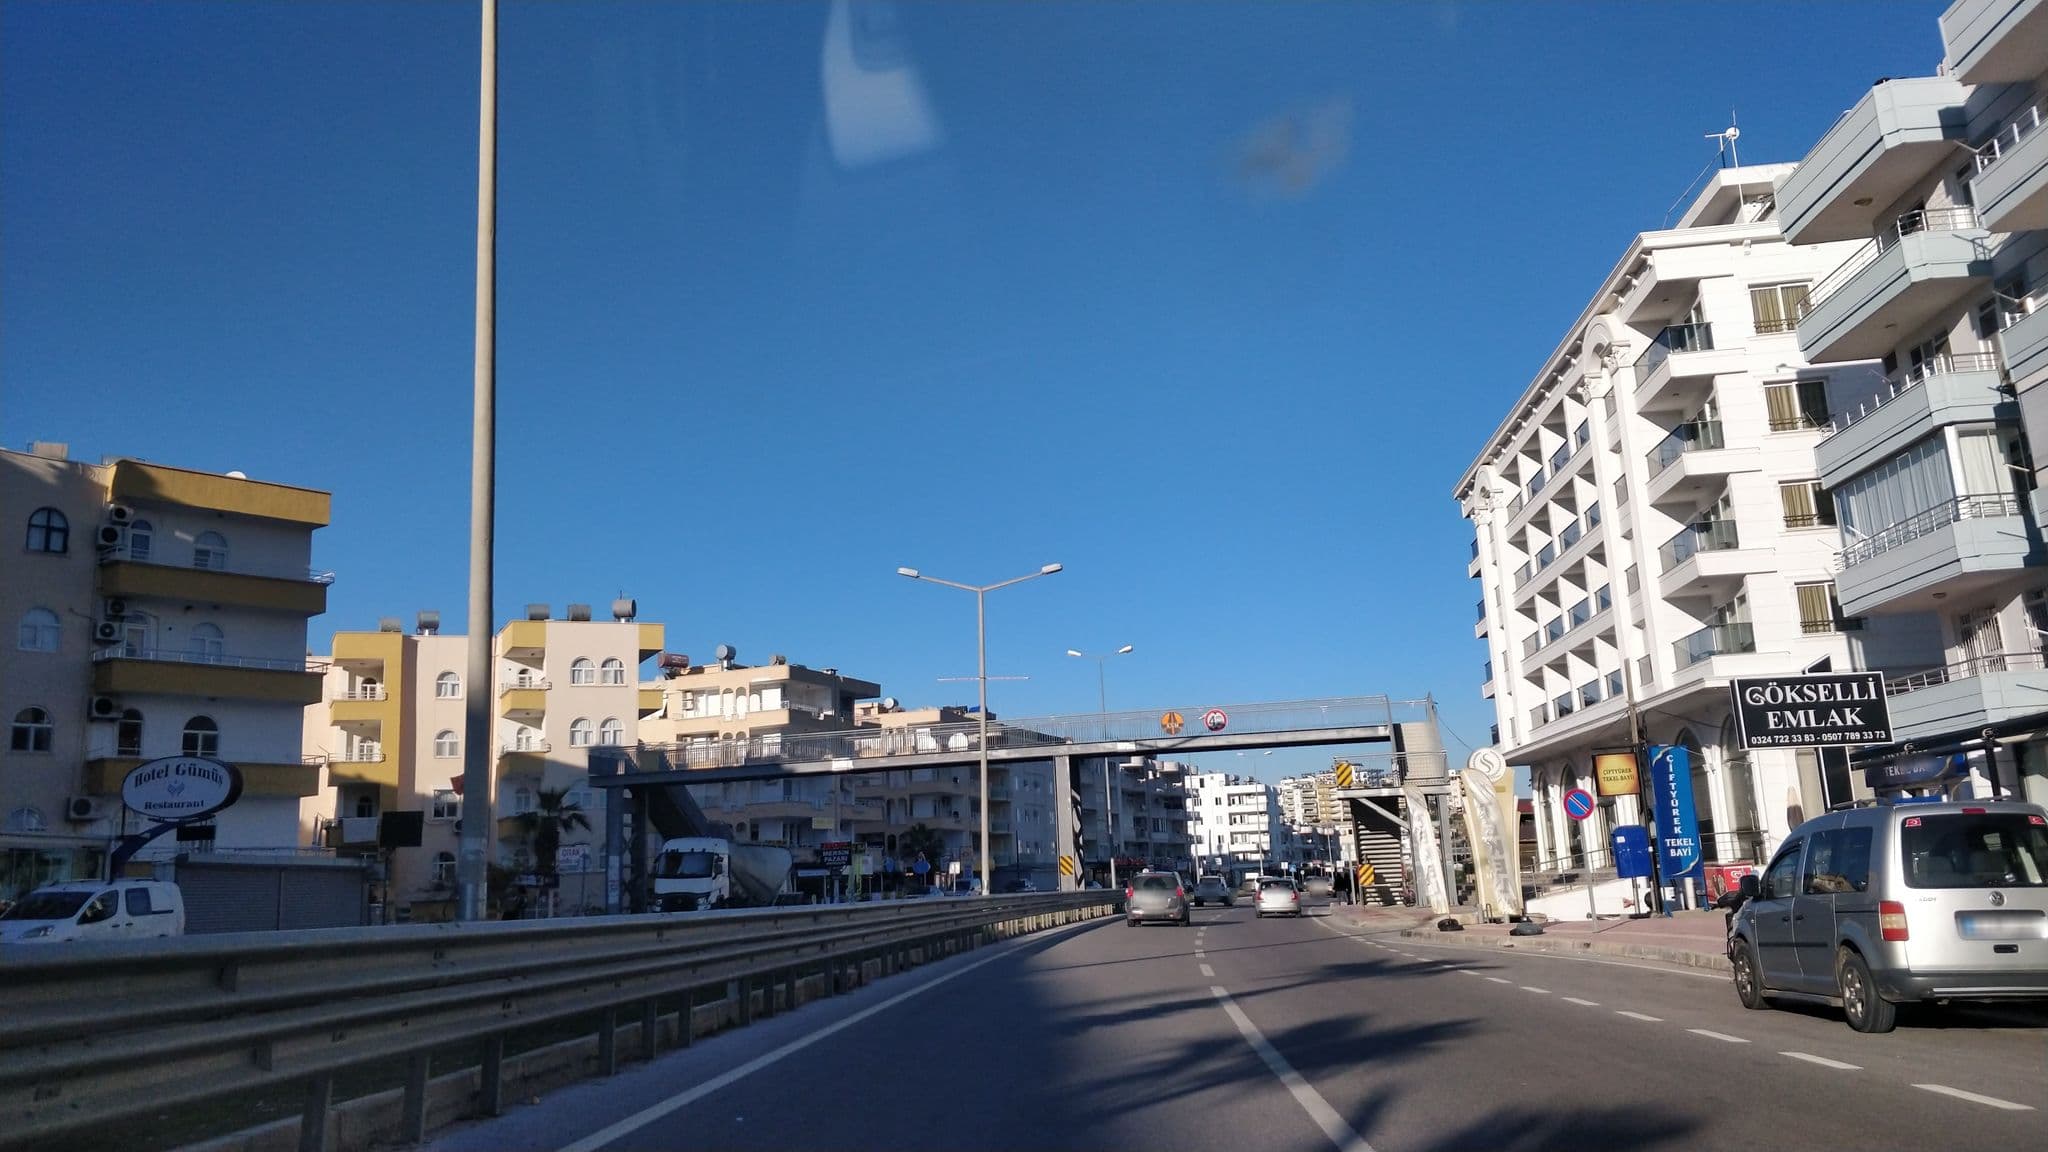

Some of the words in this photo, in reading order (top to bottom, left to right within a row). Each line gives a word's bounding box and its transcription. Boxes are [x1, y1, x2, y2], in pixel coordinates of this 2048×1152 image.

[1745, 677, 1879, 706] GÖKSELLİ
[1766, 707, 1866, 729] EMLAK
[1751, 735, 1772, 744] 0324
[1774, 734, 1789, 743] 722
[1791, 734, 1802, 743] 33
[1804, 733, 1815, 742] 83
[1822, 732, 1842, 741] 0507
[1844, 731, 1860, 740] 789
[1862, 731, 1873, 740] 33
[1874, 730, 1886, 739] 73
[134, 764, 170, 788] Hotel
[144, 800, 204, 810] Restaurant
[1665, 838, 1695, 847] TEKEL
